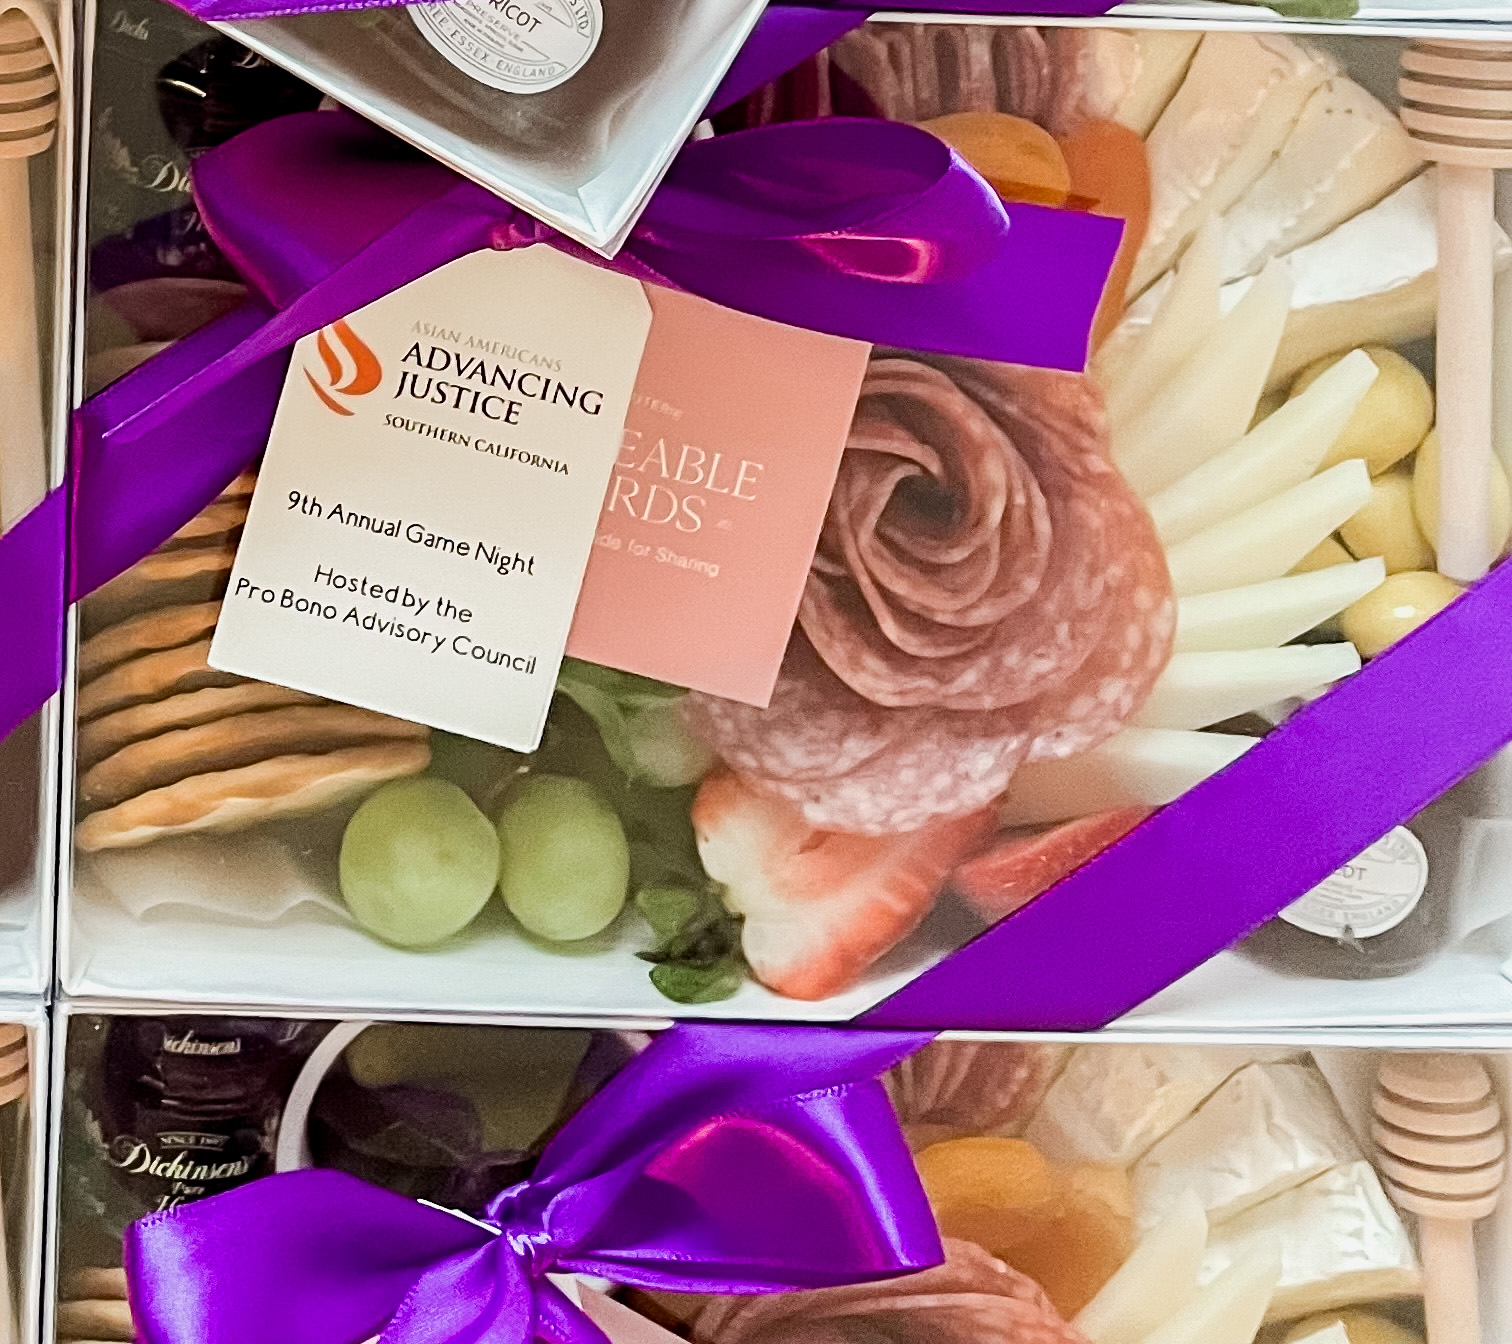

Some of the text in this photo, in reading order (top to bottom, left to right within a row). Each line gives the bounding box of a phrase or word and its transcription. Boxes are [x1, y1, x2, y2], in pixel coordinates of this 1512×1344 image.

[450, 30, 489, 62] ESSEX
[496, 60, 556, 77] ENGLAND
[411, 320, 562, 372] ASIAN AMERICANS
[395, 371, 523, 425] JUSTICE
[402, 342, 604, 415] ADVANCING
[384, 414, 569, 476] SOUTHERN CALIFORNIA
[288, 490, 535, 576] 9th Annual Game Night
[314, 564, 473, 623] Hosted by the
[235, 578, 537, 674] Pro Bono Advisory Council
